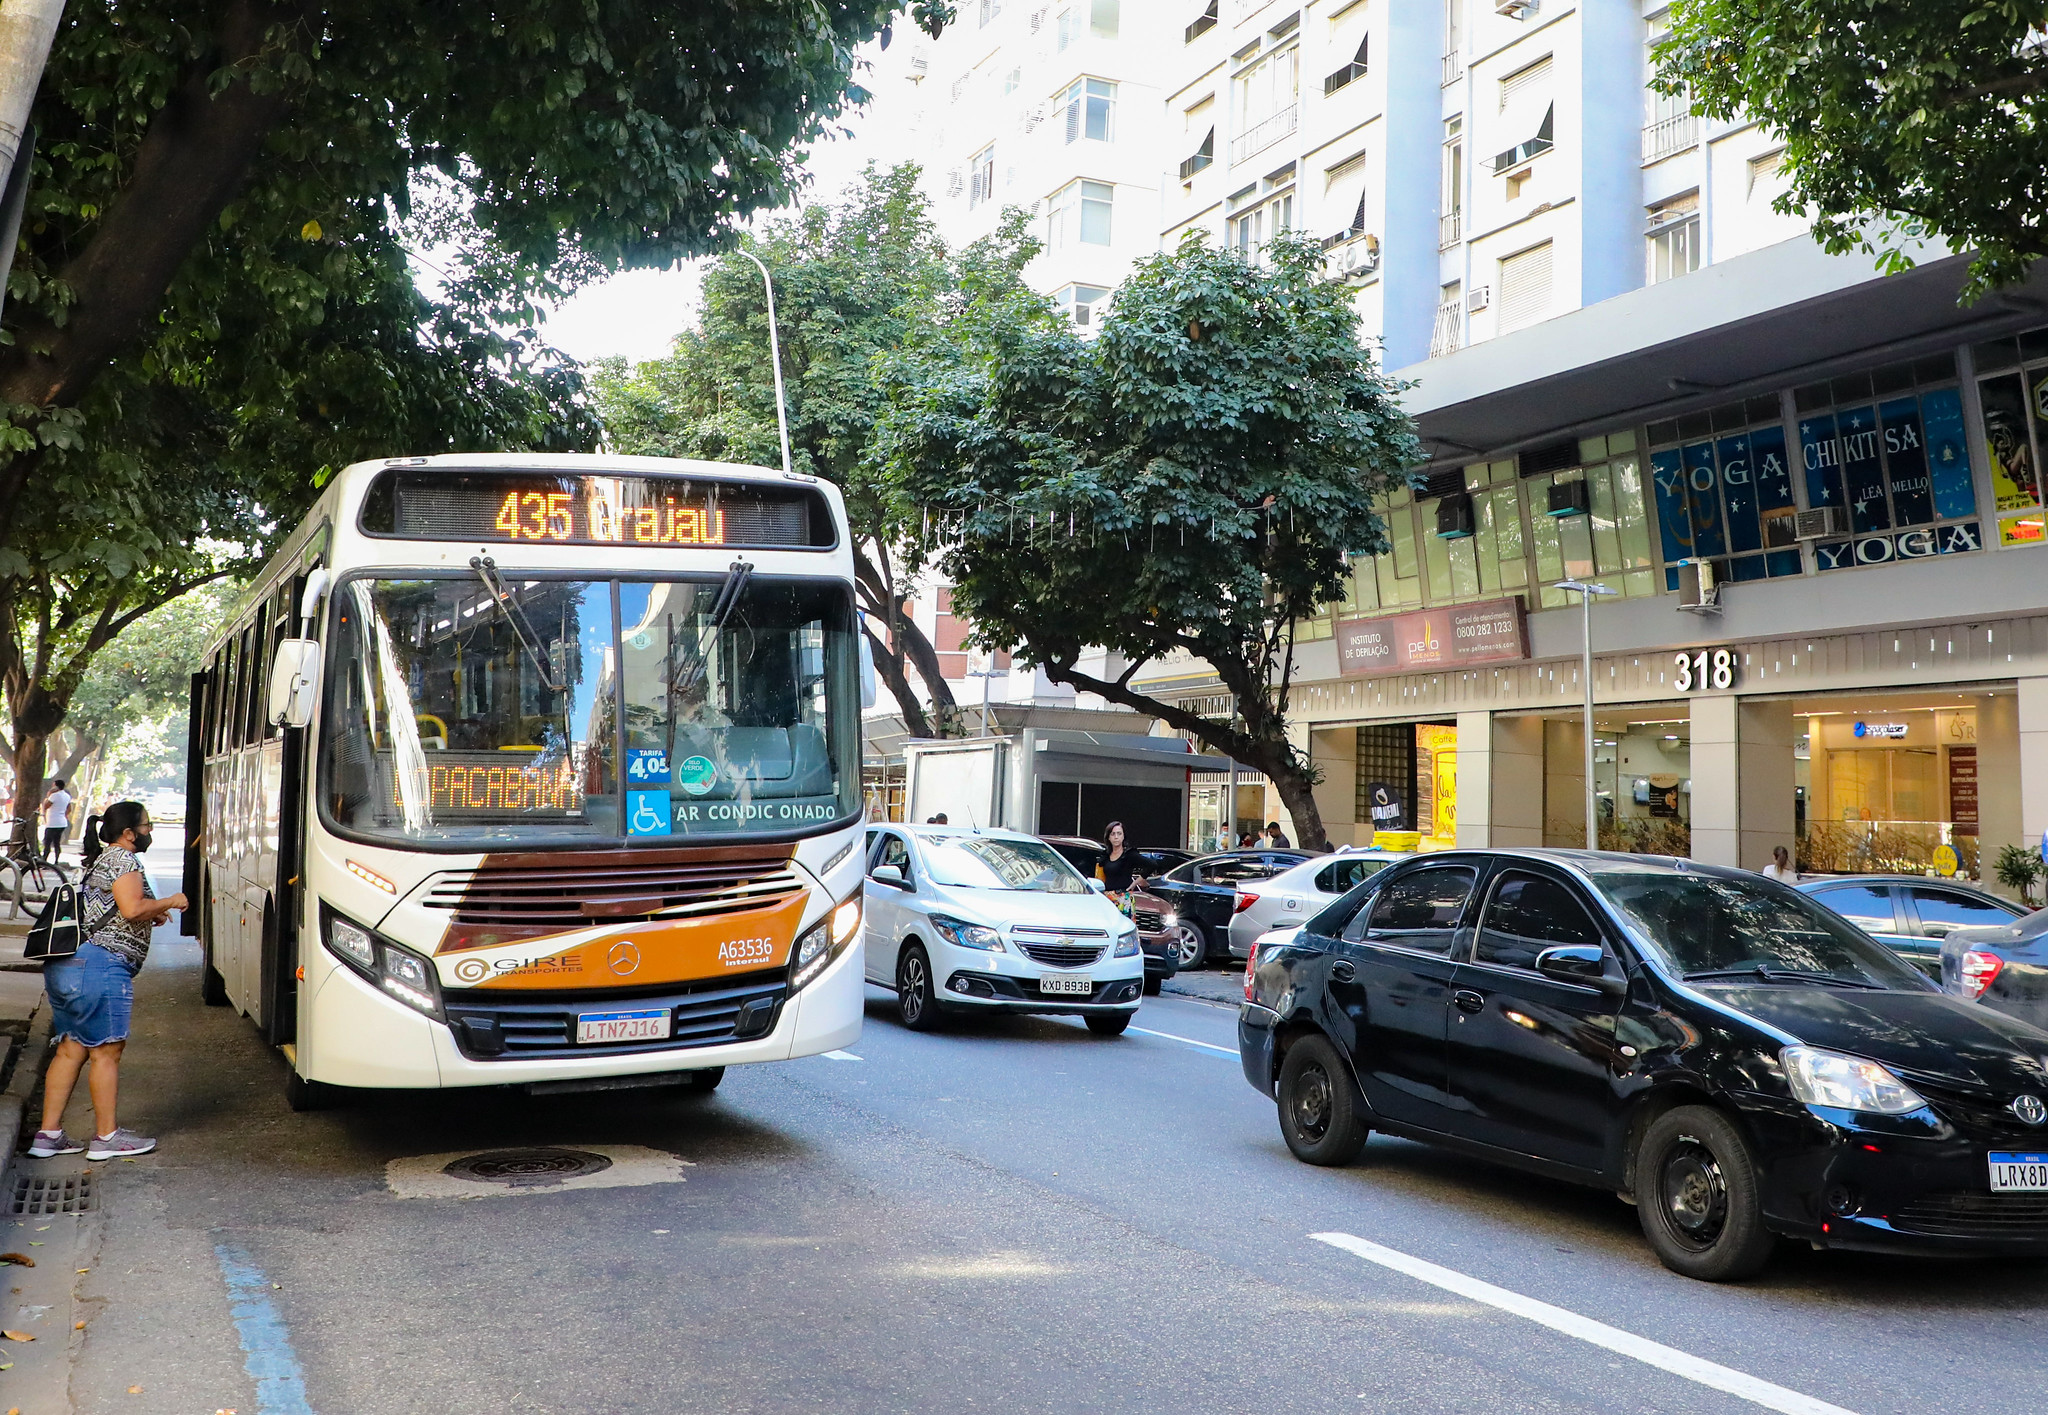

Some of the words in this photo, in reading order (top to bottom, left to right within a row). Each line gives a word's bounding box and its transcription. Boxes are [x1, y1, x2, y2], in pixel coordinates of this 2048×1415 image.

[1655, 453, 1785, 497] YOGA
[1862, 485, 1884, 500] LEA
[1892, 476, 1929, 493] MELLO
[495, 491, 574, 540] 435
[1818, 525, 1982, 568] YOGA
[1473, 614, 1479, 623] de
[1350, 633, 1381, 645] INSTITUTO
[1457, 626, 1475, 639] 0800
[1477, 623, 1491, 636] 282
[1494, 621, 1512, 633] 1233
[1346, 649, 1354, 659] DE
[1356, 644, 1389, 658] DEPILAÇÃO
[1412, 651, 1440, 659] MENOS
[1674, 650, 1733, 692] 318
[629, 757, 670, 779] 4,05
[676, 806, 700, 822] AR
[718, 937, 773, 960] A63536
[494, 956, 582, 970] GIRE
[725, 956, 769, 967] Intersul
[494, 966, 584, 977] TRANSPORTES
[586, 1020, 659, 1039] LTN7J16
